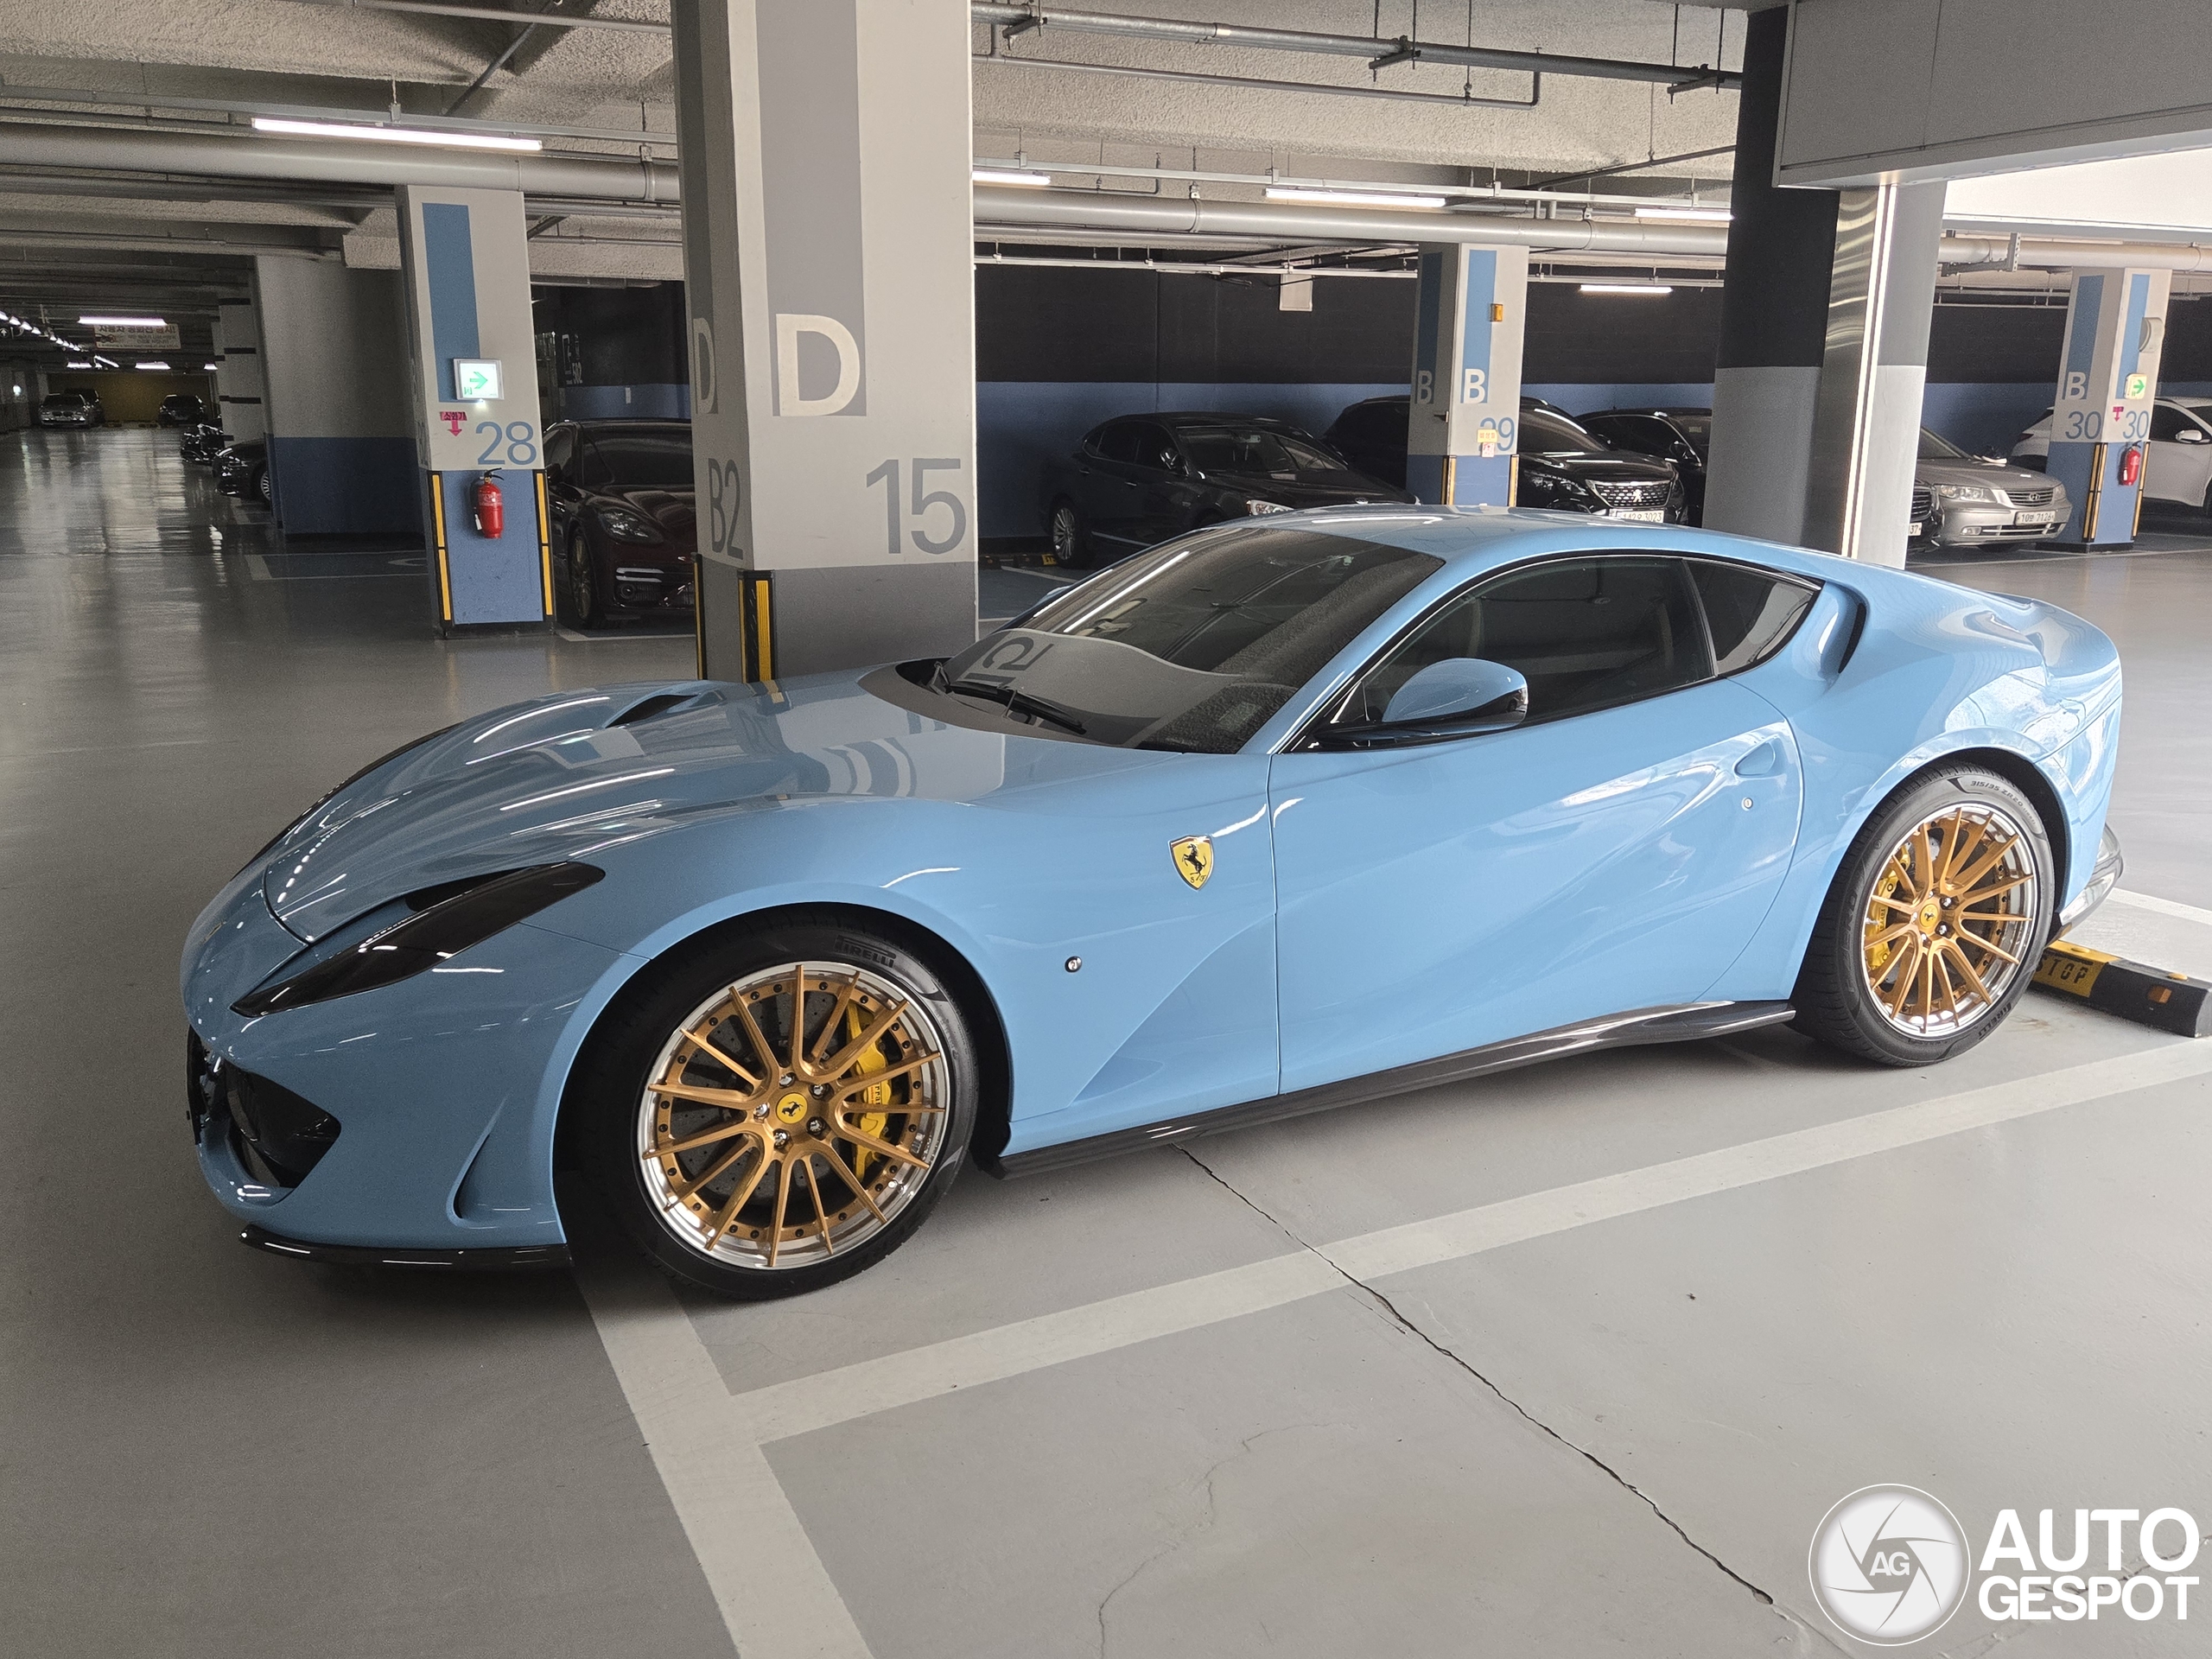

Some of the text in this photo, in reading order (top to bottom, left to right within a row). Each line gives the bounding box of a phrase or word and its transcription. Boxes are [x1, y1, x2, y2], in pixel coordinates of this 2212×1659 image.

[693, 318, 715, 415] D
[776, 313, 861, 416] D
[1417, 370, 1433, 404] B
[1463, 368, 1485, 404] B
[2065, 372, 2087, 400] B
[2065, 410, 2102, 440] 30
[2122, 410, 2150, 439] 30
[475, 421, 537, 466] 28
[708, 457, 744, 560] B2
[866, 457, 967, 555] 15
[834, 934, 896, 969] PIRELLI
[2035, 956, 2088, 983] STOP
